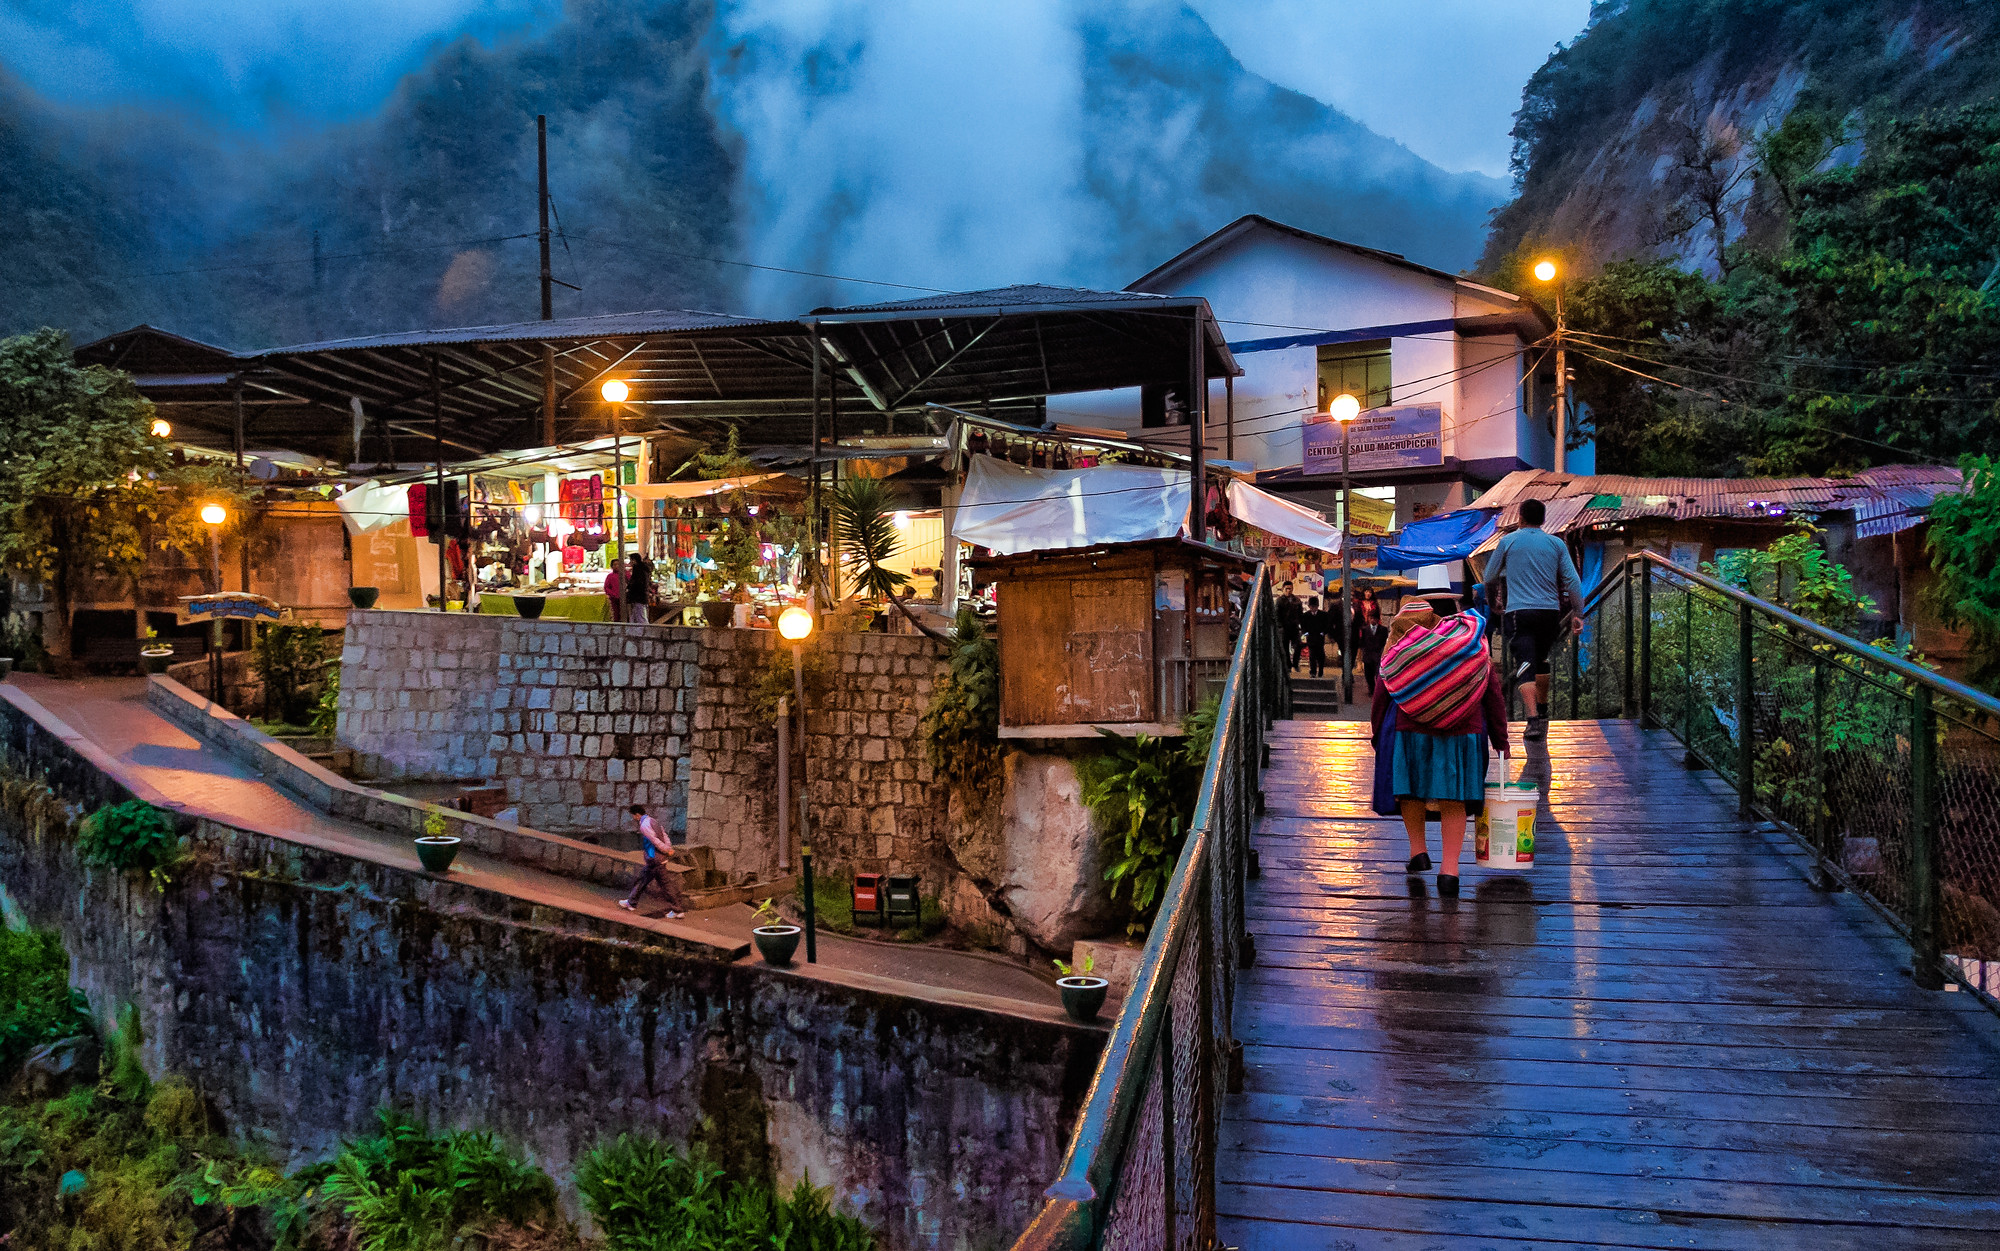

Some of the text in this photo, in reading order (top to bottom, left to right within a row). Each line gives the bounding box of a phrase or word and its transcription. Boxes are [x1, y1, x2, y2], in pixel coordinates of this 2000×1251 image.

[1307, 445, 1337, 456] CENTRO
[1350, 443, 1376, 455] SALUD
[1377, 438, 1438, 451] MACHUPICCHU
[1244, 536, 1260, 547] EL
